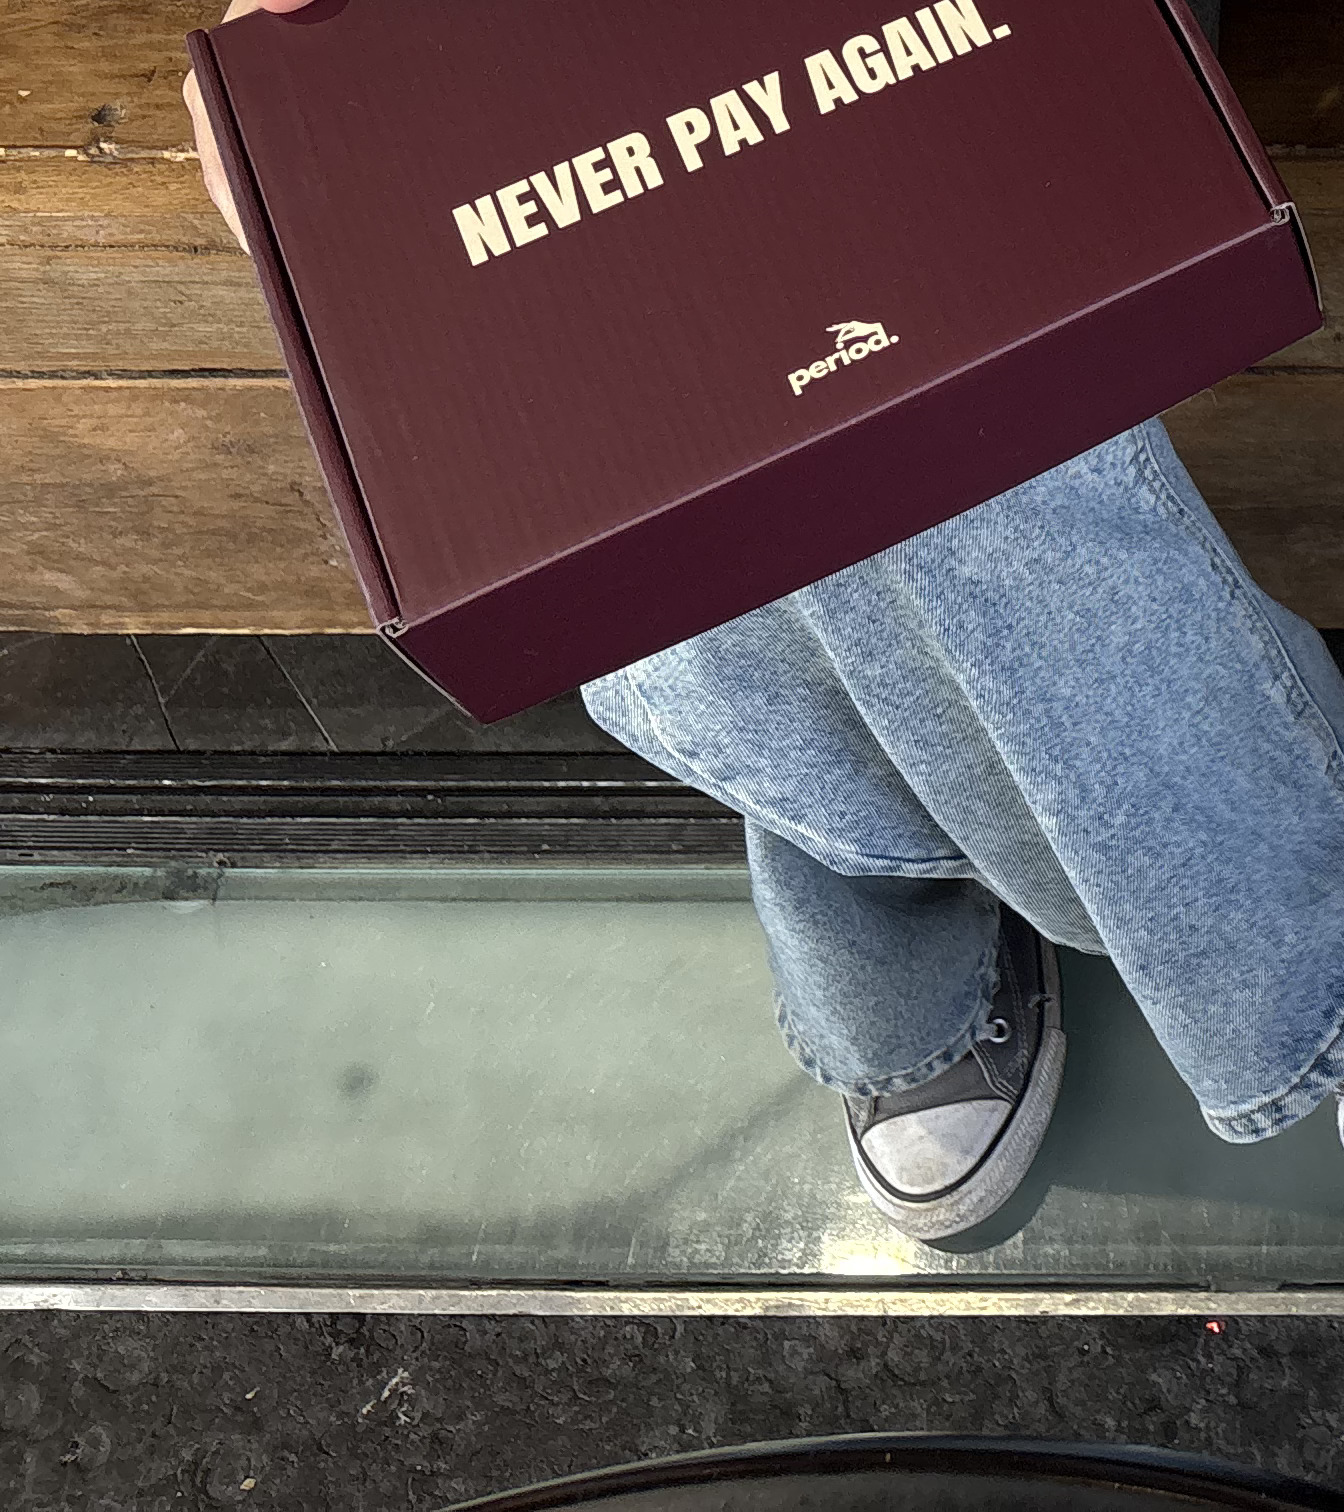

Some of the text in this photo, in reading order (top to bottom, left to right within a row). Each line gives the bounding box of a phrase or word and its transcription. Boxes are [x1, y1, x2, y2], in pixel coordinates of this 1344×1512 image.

[452, 131, 664, 267] NEVER
[666, 70, 791, 173] PAY
[787, 324, 900, 396] period.
